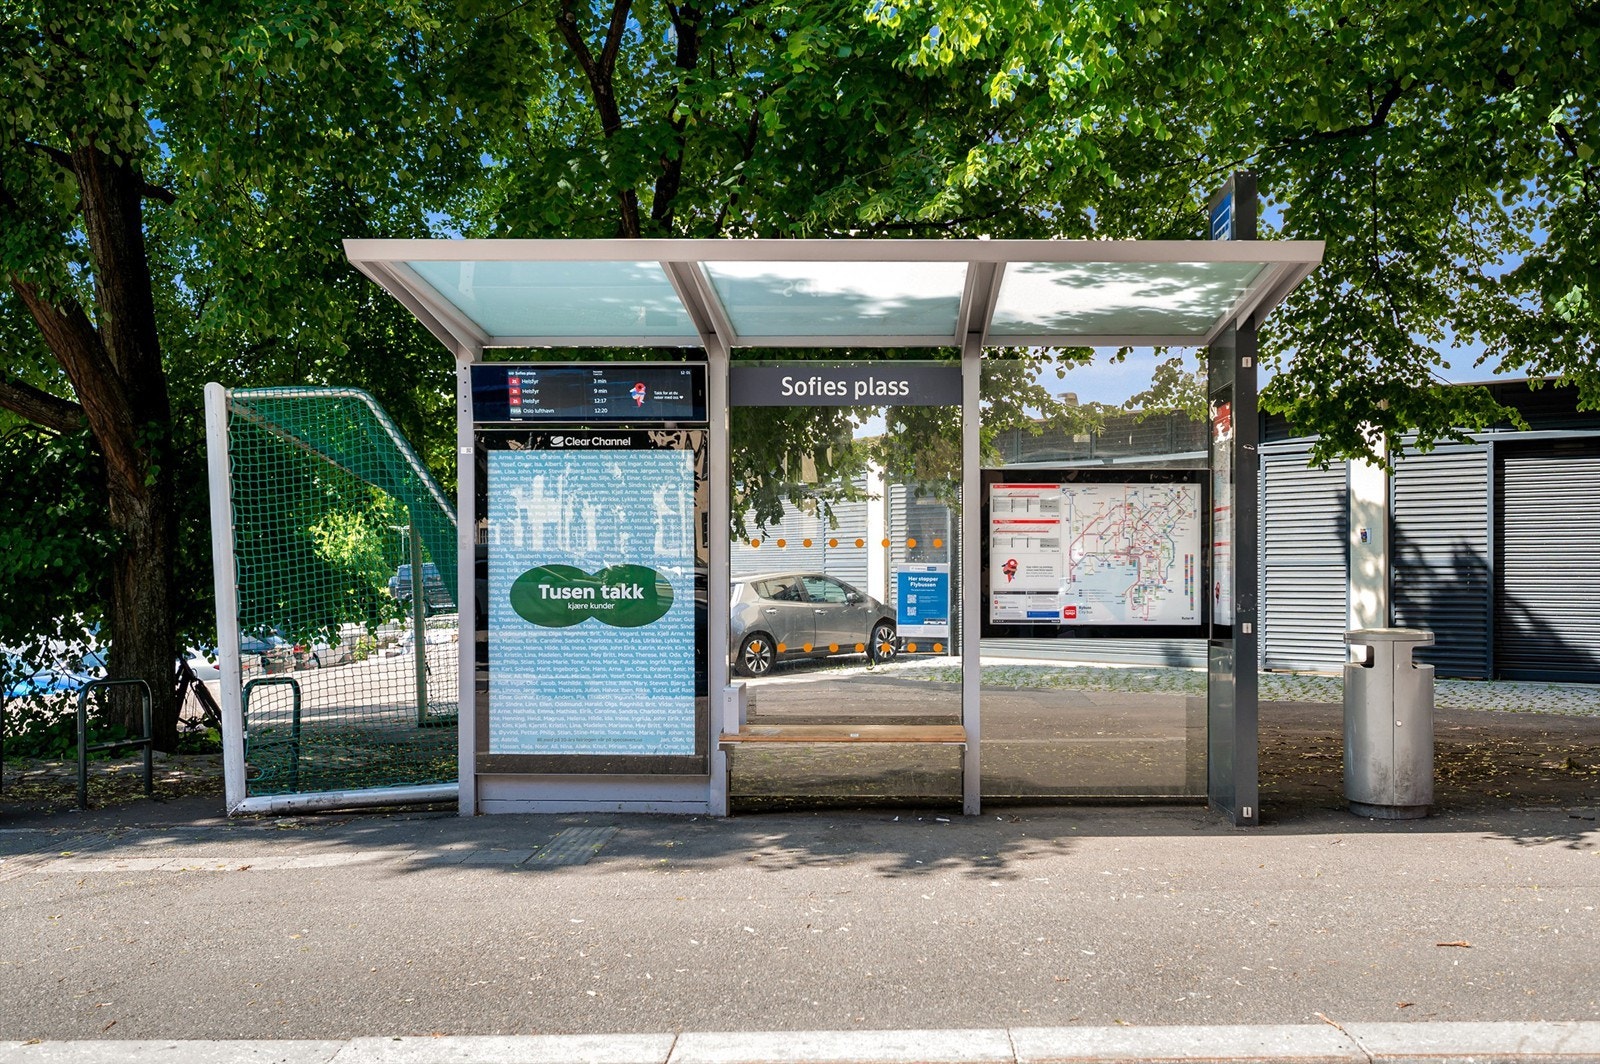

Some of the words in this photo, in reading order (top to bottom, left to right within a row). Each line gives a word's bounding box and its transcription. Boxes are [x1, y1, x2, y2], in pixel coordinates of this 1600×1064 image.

[781, 376, 847, 397] Sofies
[854, 376, 910, 400] plass
[565, 437, 590, 447] Clear
[591, 437, 631, 447] Channel
[538, 584, 595, 600] Tusen
[600, 583, 645, 600] takk
[567, 602, 589, 611] kjære
[590, 602, 615, 610] kunder
